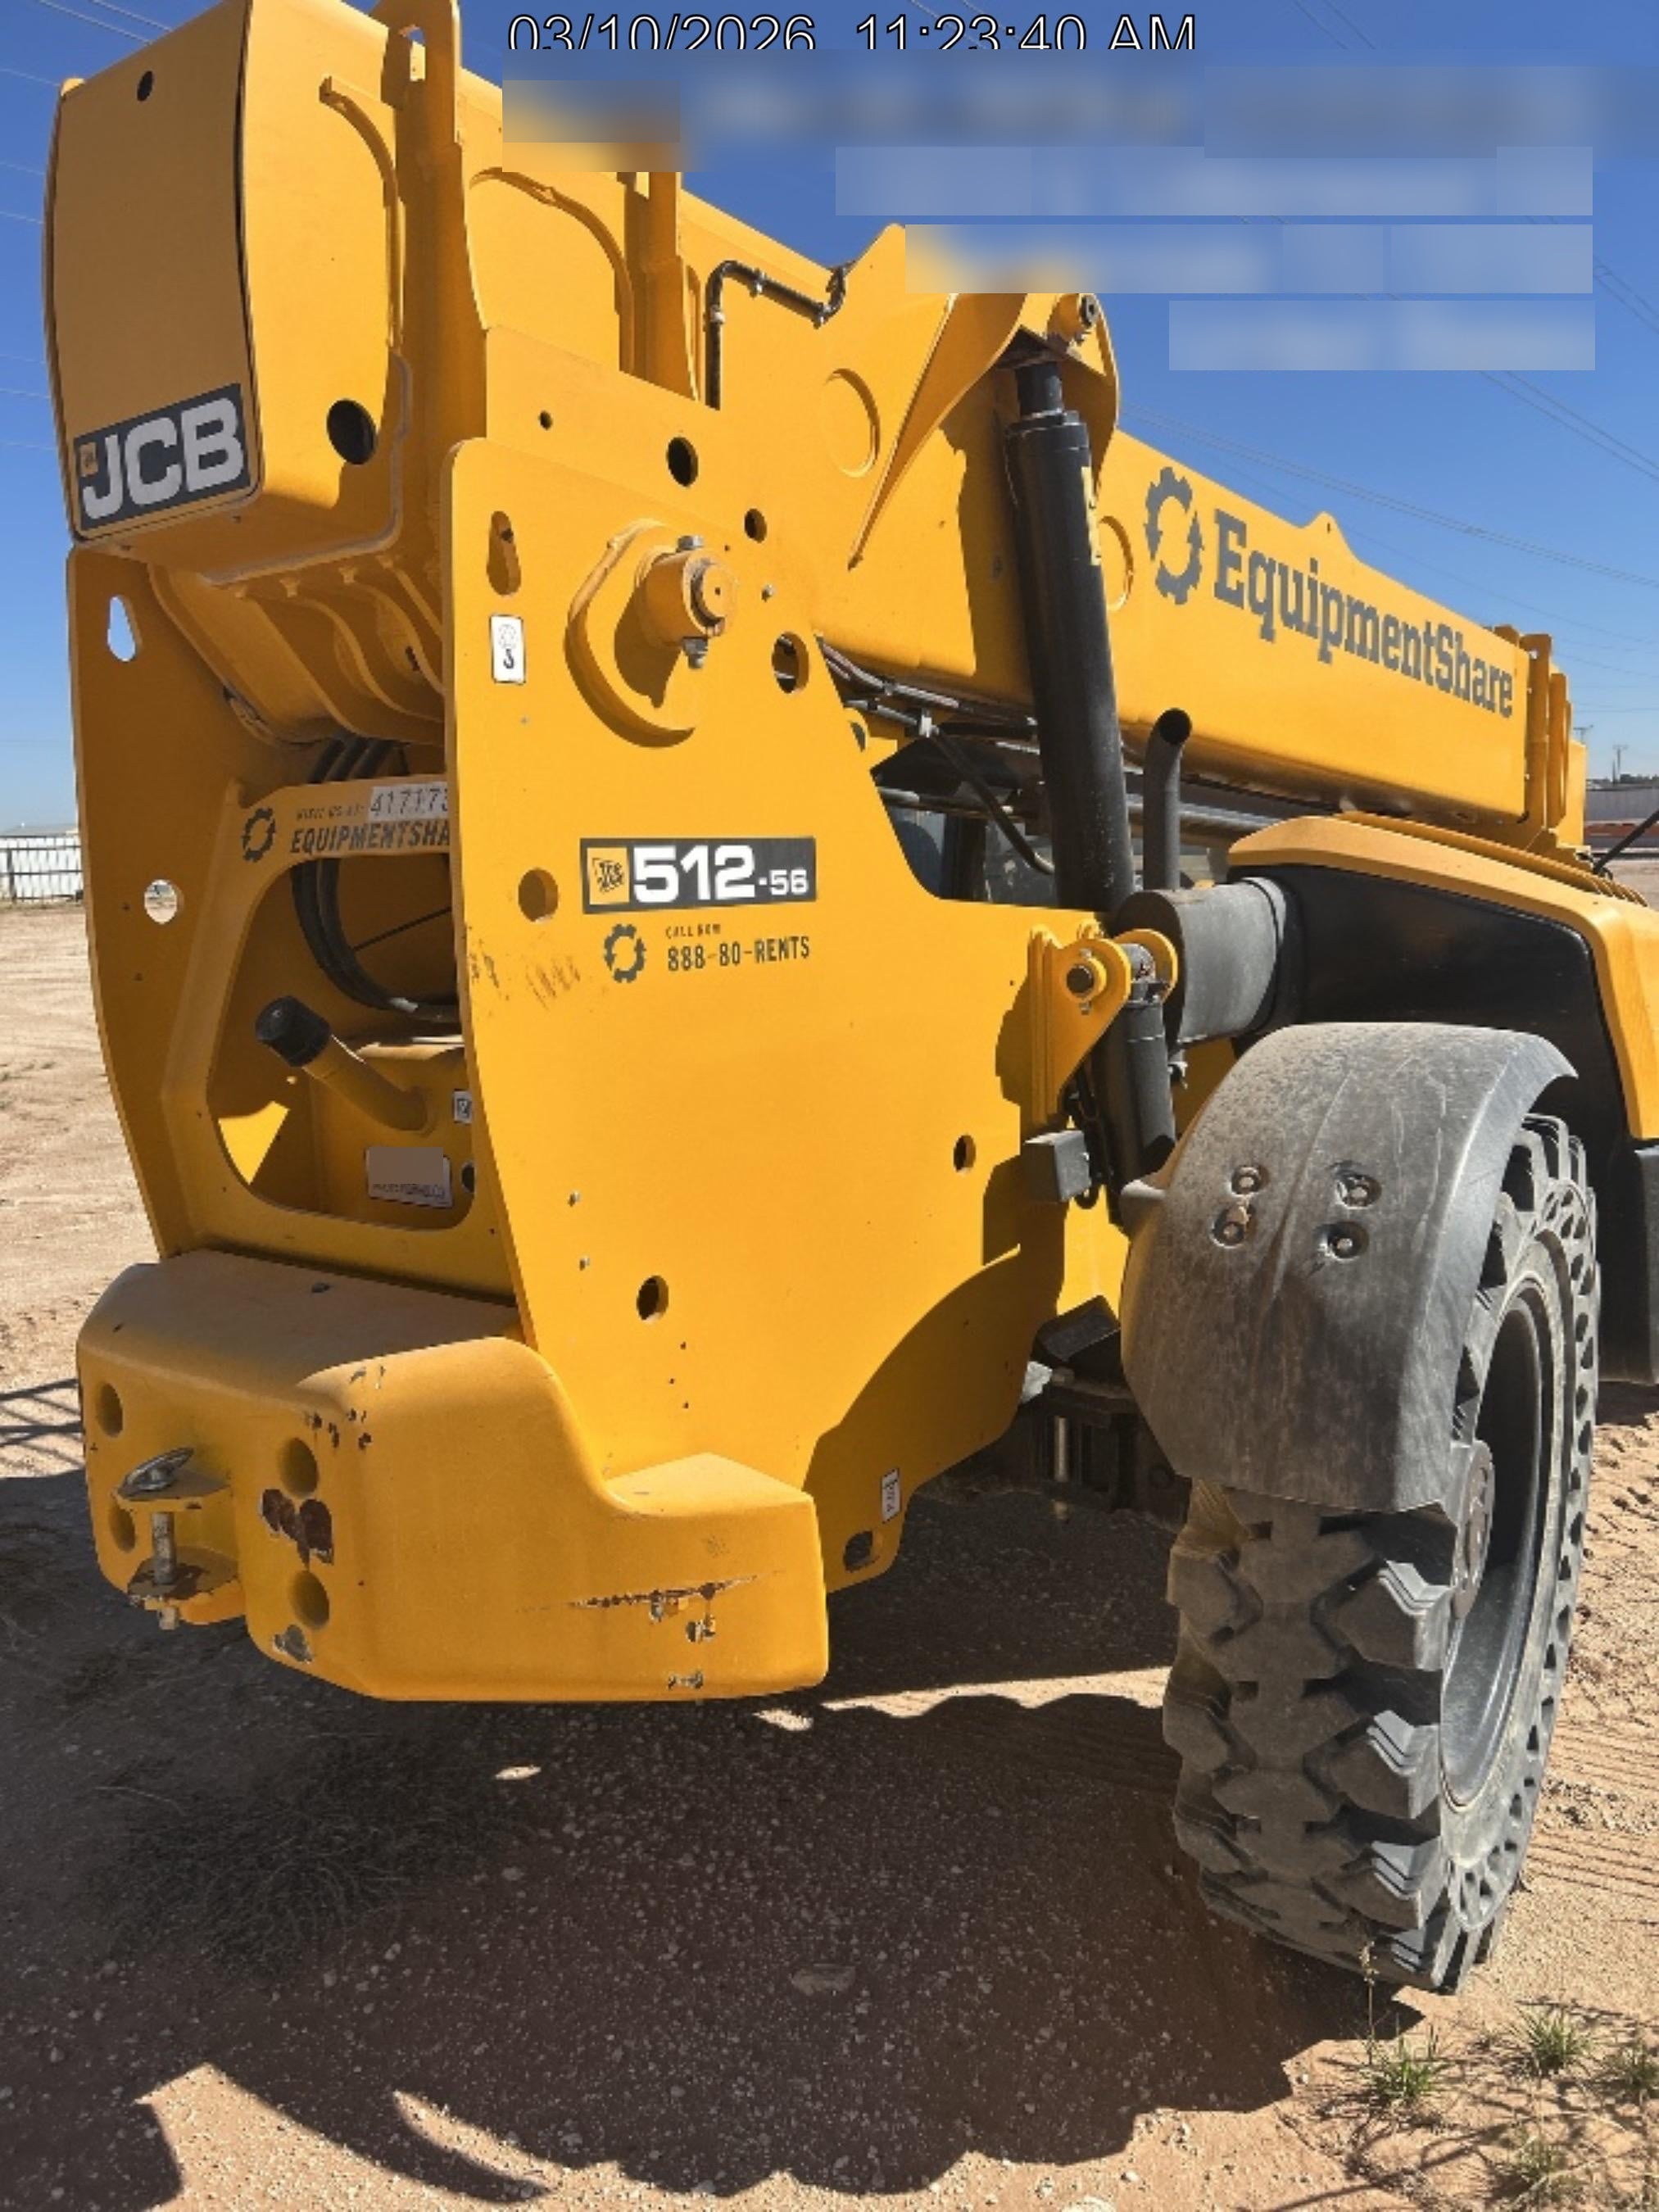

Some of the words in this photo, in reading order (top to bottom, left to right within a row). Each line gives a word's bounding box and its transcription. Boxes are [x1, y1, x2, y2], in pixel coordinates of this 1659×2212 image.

[82, 397, 244, 519] JCB
[1213, 508, 1513, 718] EquipmentShare
[668, 936, 809, 971] 888-80-RENTS
